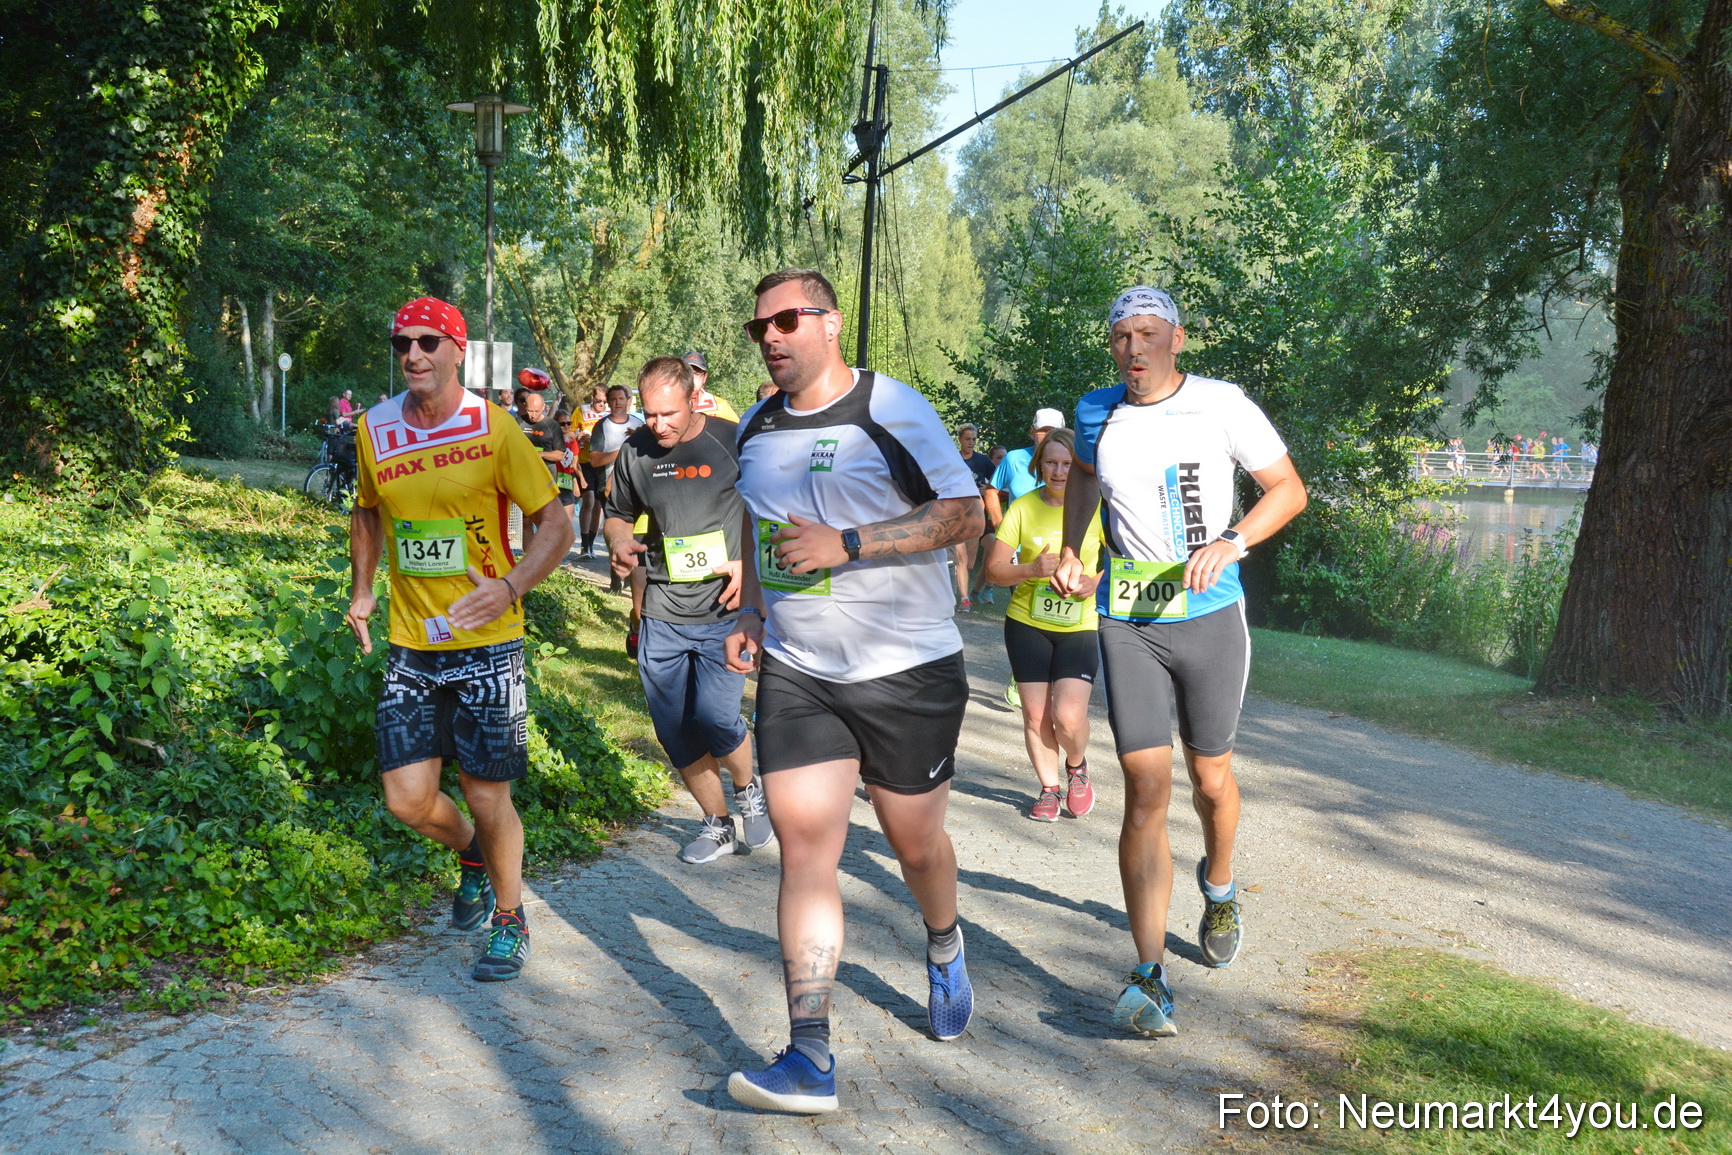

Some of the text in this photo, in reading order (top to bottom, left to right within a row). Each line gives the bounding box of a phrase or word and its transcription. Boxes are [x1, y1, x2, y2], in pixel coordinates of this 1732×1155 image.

[377, 444, 493, 485] MAX BÖGL
[560, 477, 571, 485] 415
[1157, 485, 1167, 508] WASTE
[1161, 510, 1170, 536] WATER
[401, 539, 455, 560] 1347
[684, 551, 708, 568] 38
[781, 572, 812, 582] Alexander
[1118, 579, 1175, 602] 2100
[1043, 598, 1073, 615] 917
